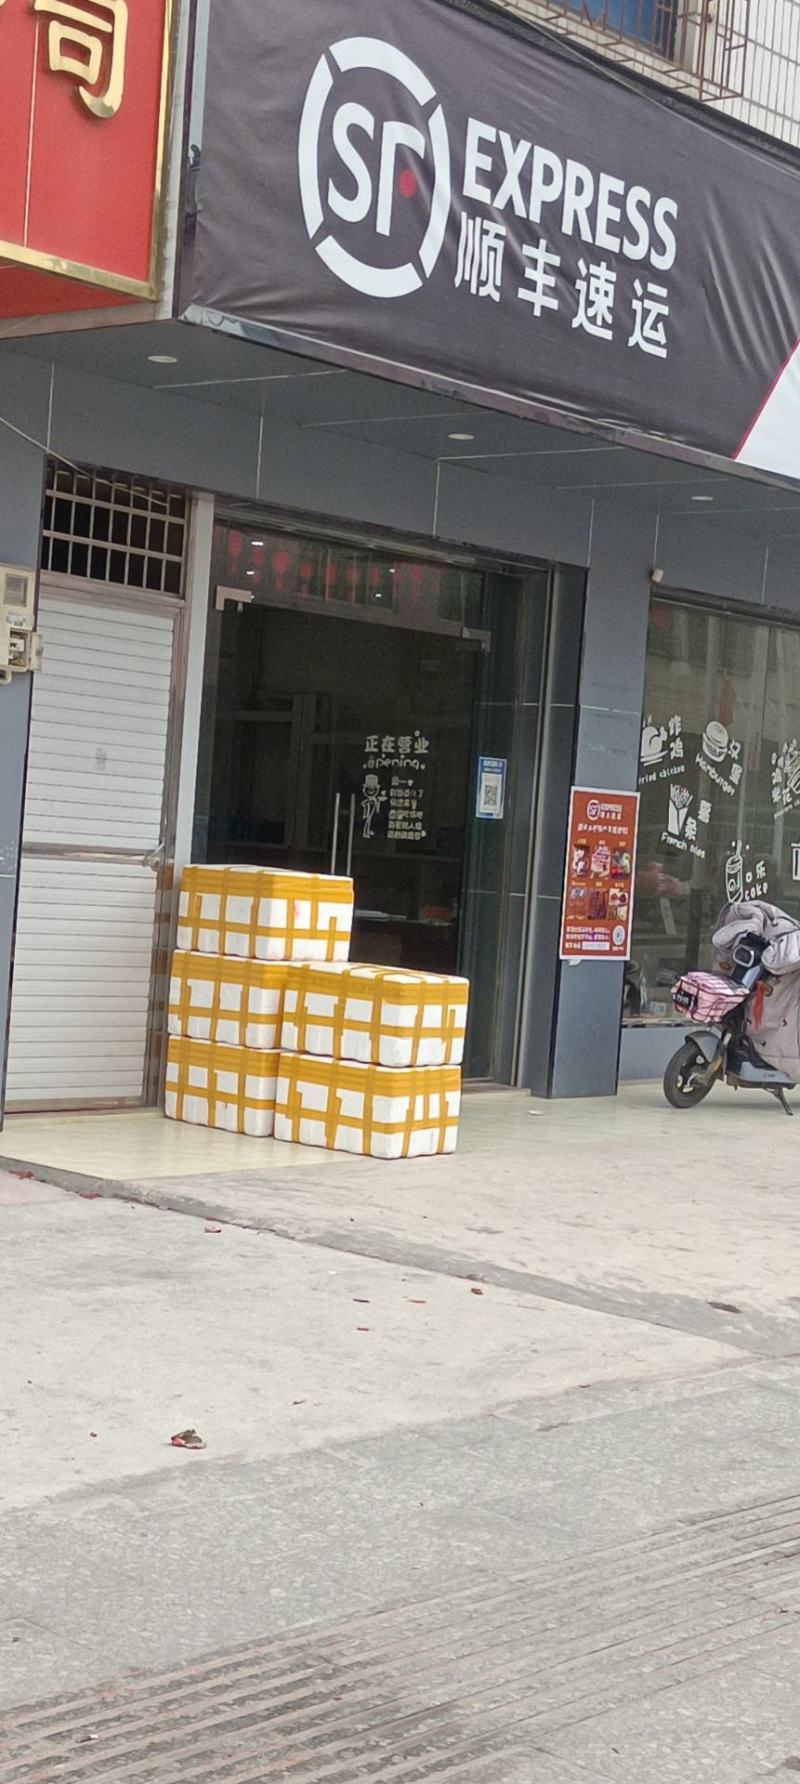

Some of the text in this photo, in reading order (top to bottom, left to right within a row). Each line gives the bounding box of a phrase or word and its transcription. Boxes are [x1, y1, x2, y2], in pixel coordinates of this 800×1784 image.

[34, 0, 128, 118] 司
[462, 117, 679, 271] EXPRESS
[454, 210, 670, 359] 顺丰速运
[364, 735, 430, 754] 正在营业
[744, 881, 769, 901] coke
